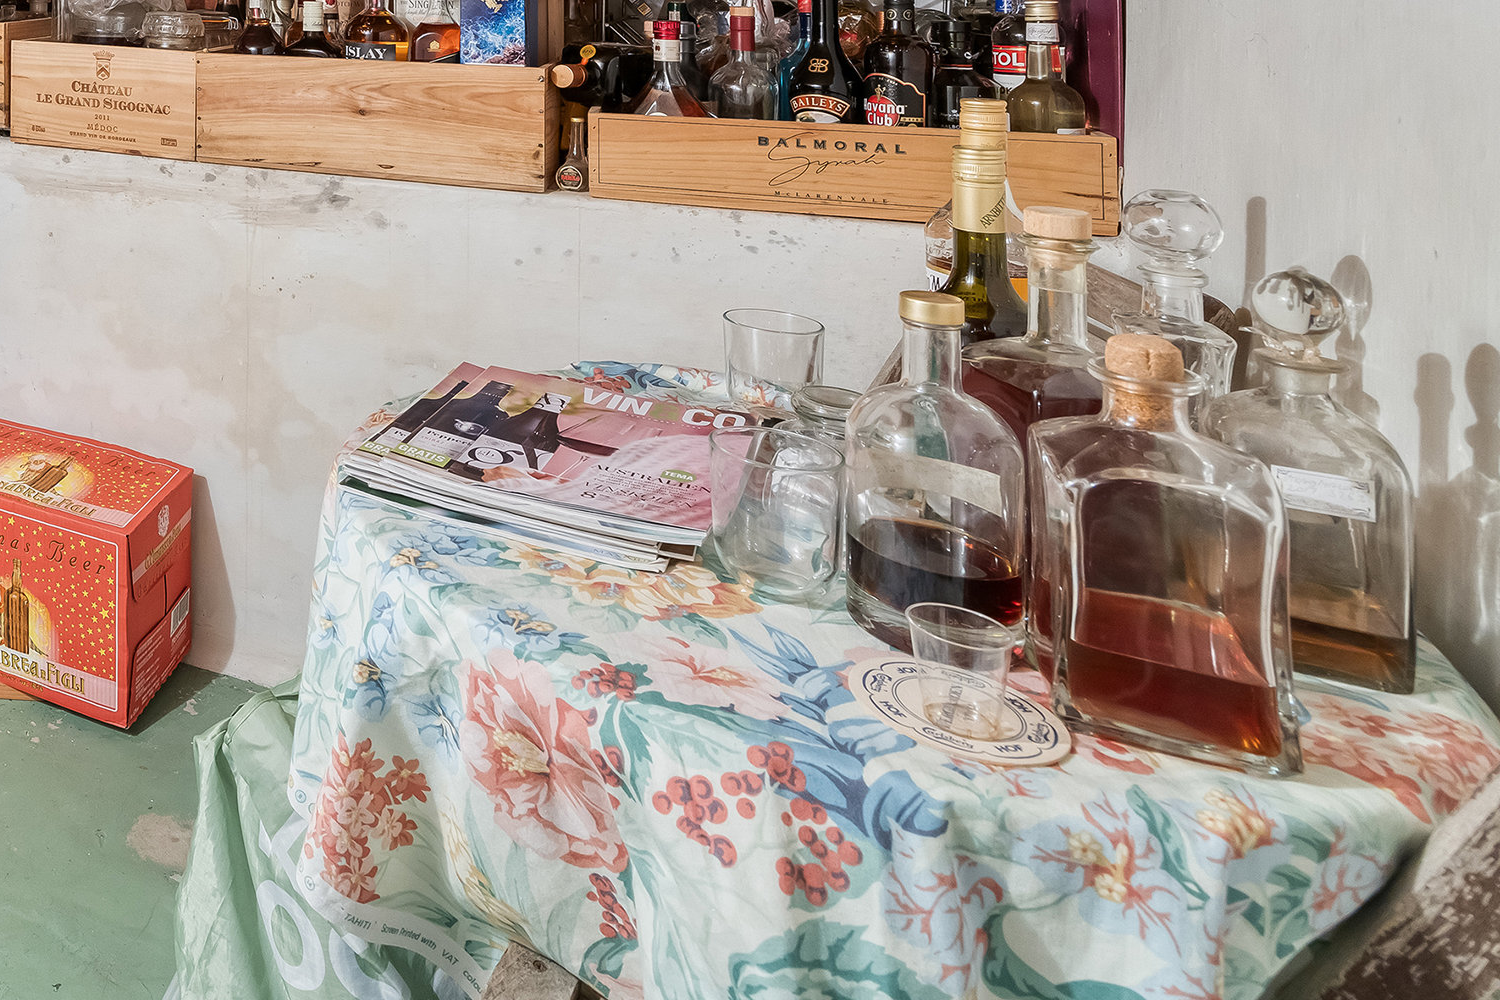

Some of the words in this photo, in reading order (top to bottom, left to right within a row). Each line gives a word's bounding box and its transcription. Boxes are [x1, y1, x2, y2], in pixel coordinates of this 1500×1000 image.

[345, 45, 388, 60] ISLAY
[36, 93, 53, 104] LE
[55, 93, 100, 109] GRAND
[103, 98, 171, 116] SIGOGNAC
[792, 96, 846, 112] BAILEYS
[94, 113, 110, 121] 2011
[867, 112, 893, 127] Club
[86, 123, 119, 133] MÉDOC
[107, 135, 137, 143] BORDEAUX
[757, 136, 907, 155] BALMORAL
[768, 132, 885, 187] Syrah
[850, 195, 889, 204] VALE
[583, 387, 653, 416] VIN
[682, 408, 747, 429] CO
[398, 443, 446, 463] GRATIS
[105, 454, 157, 478] Beer
[664, 470, 694, 481] TEMA
[591, 464, 711, 493] AUSTRALIEN
[46, 539, 107, 576] Beer
[879, 700, 907, 720] HOF
[922, 727, 974, 750] Carlsberg
[996, 744, 1024, 754] HOF
[399, 926, 421, 942] Printed
[420, 935, 437, 951] with
[441, 949, 460, 966] VAT
